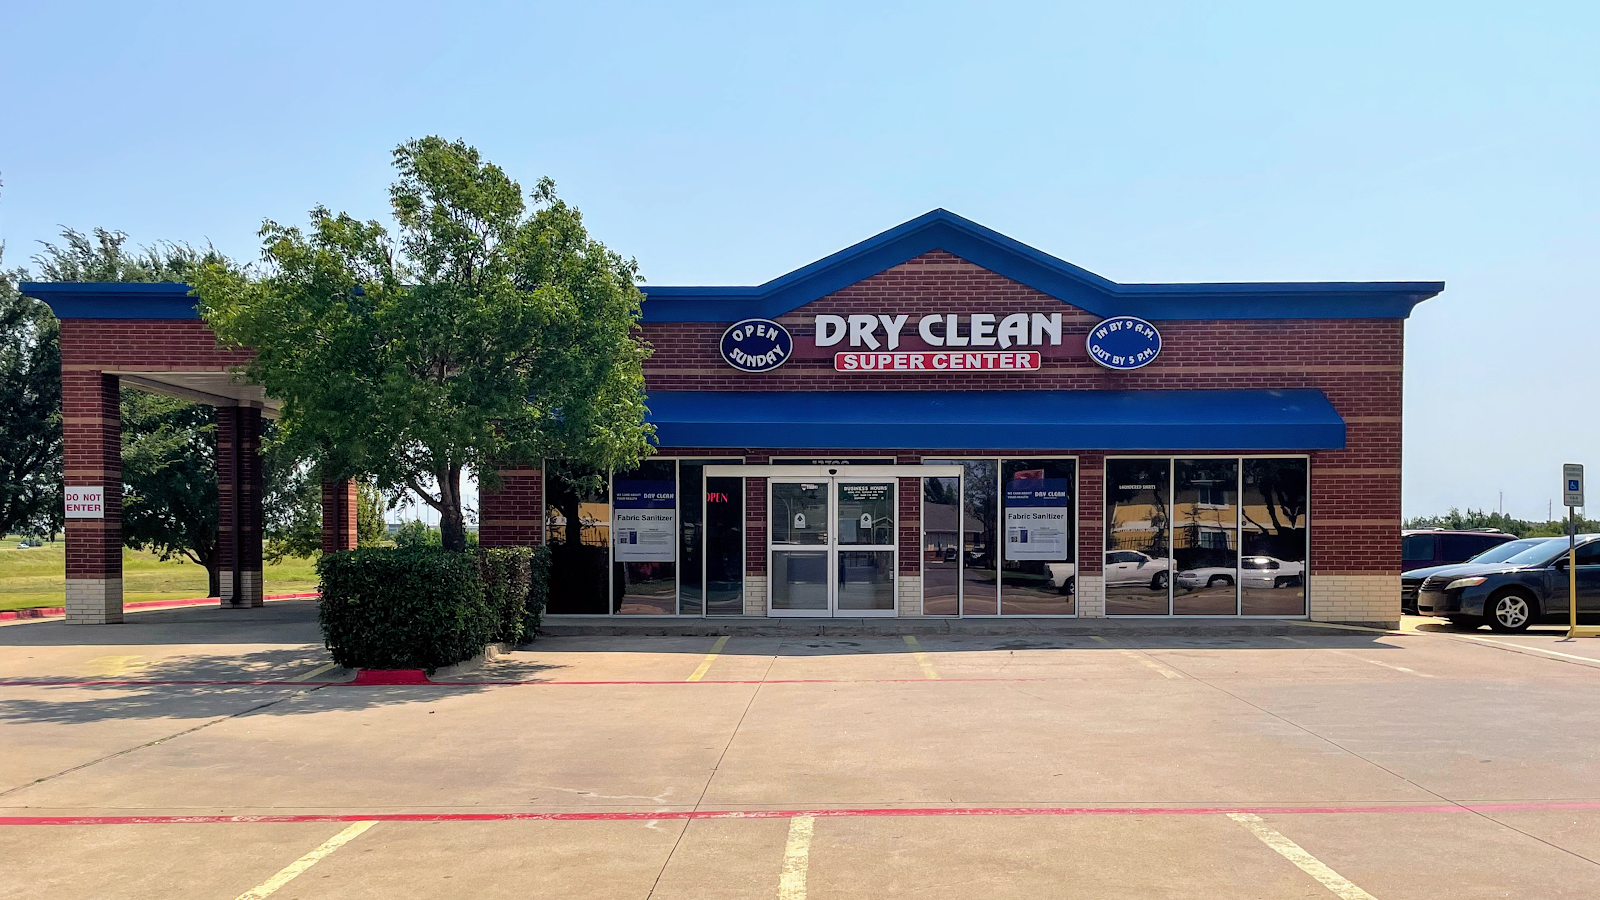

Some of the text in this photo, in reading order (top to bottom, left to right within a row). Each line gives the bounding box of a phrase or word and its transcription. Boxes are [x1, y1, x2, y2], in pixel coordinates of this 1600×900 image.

[732, 324, 779, 342] OPEN
[815, 312, 1063, 351] DRY CLEAN
[1096, 320, 1154, 341] IN BY 9 A.M.
[729, 344, 785, 367] SUNDAY
[843, 353, 1032, 370] SUPER CENTER
[1092, 344, 1156, 366] OUT BY 5 P.M.
[66, 493, 102, 501] DO NOT
